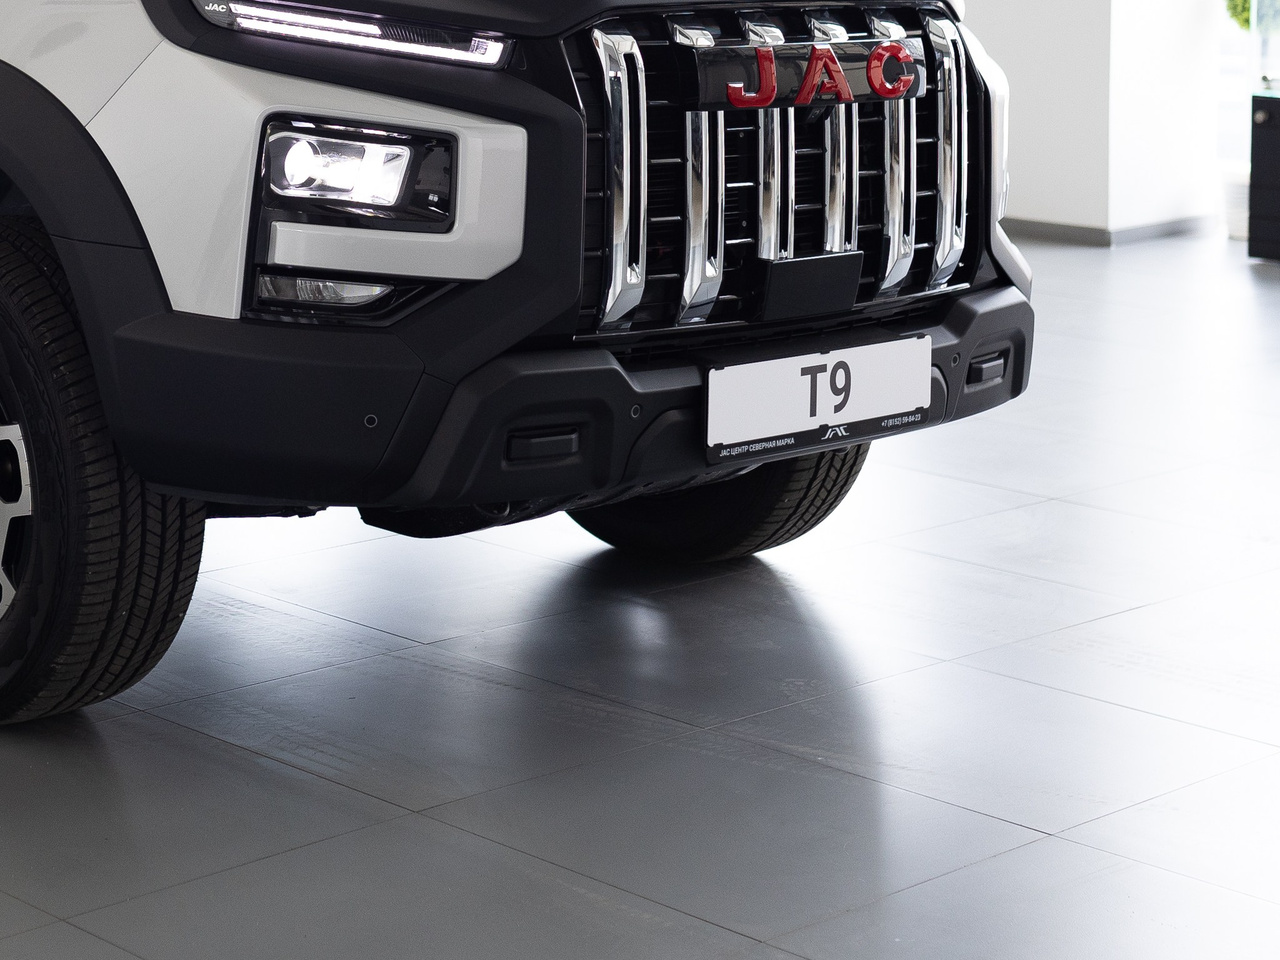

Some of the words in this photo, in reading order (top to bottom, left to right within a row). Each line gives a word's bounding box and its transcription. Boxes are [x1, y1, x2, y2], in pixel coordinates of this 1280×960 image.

[204, 3, 227, 12] JAC
[727, 41, 915, 108] JAC
[801, 361, 851, 417] T9
[821, 425, 849, 440] JAC
[720, 449, 730, 457] JAC
[731, 445, 748, 455] ЦЕНТР
[749, 441, 776, 452] СЕВЕРНАЯ
[776, 437, 795, 446] МАРКА
